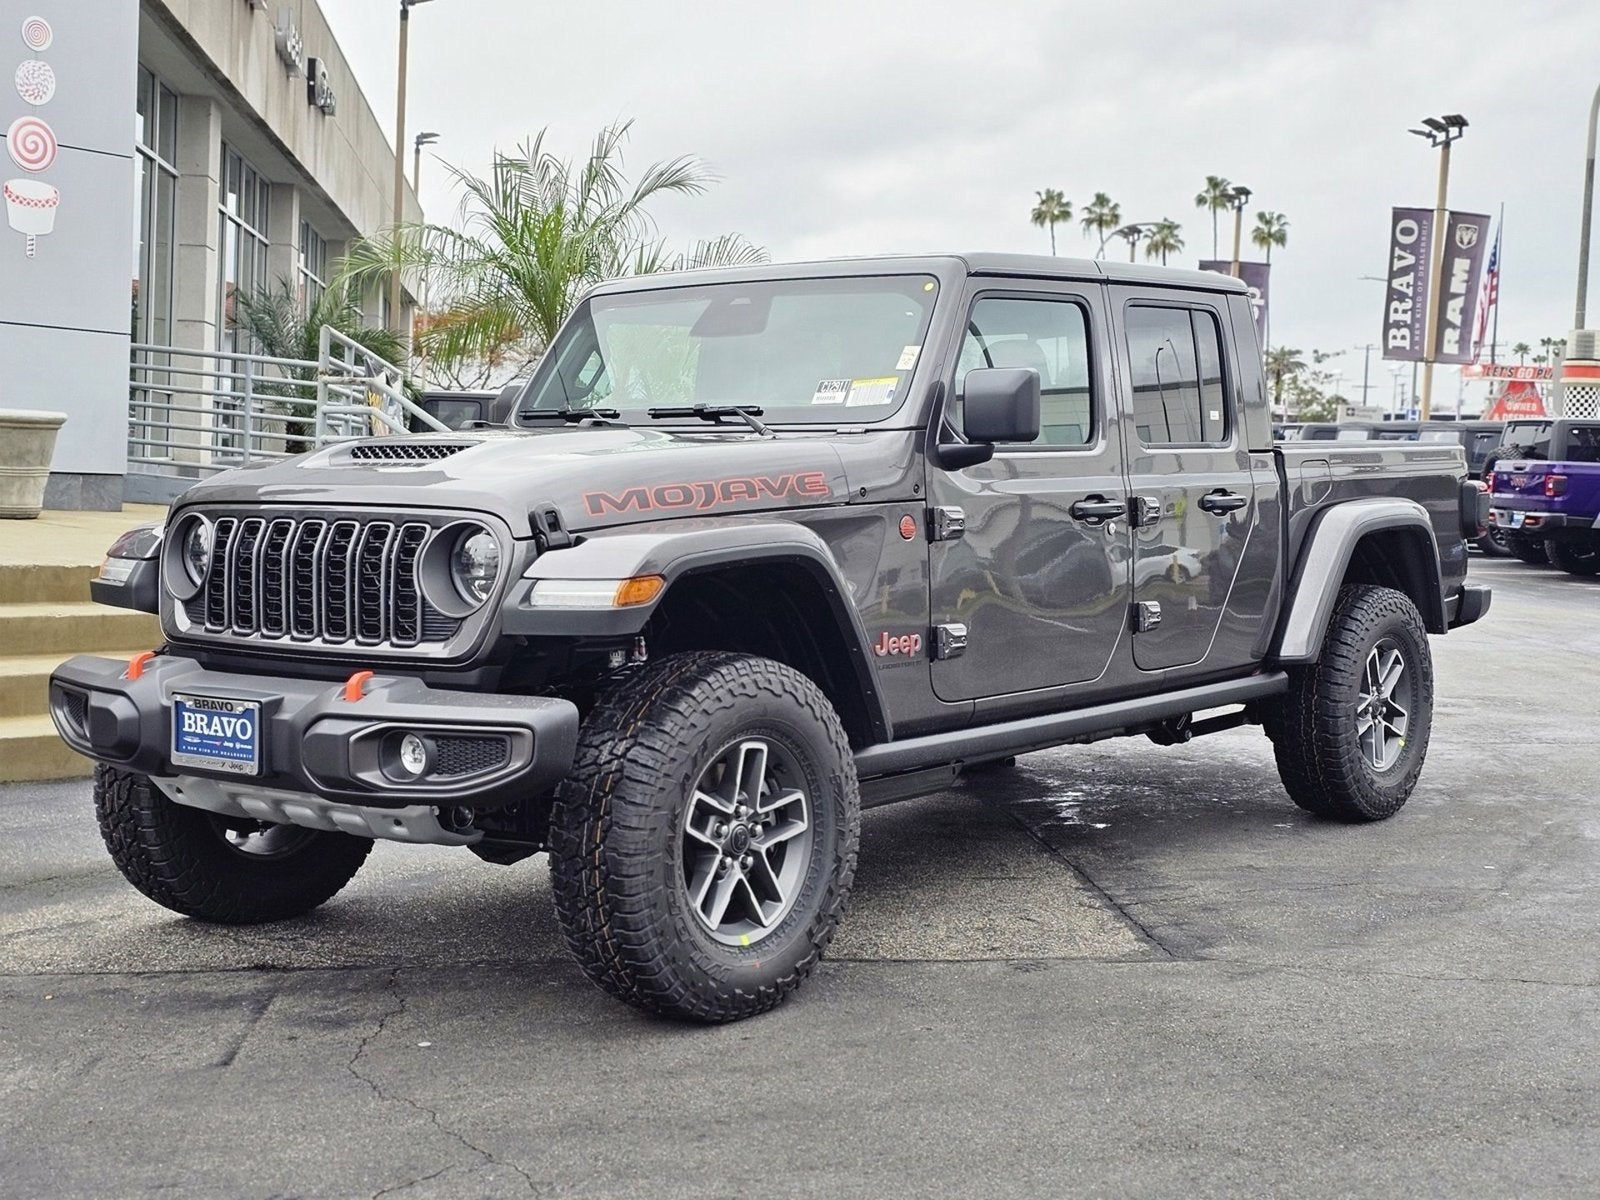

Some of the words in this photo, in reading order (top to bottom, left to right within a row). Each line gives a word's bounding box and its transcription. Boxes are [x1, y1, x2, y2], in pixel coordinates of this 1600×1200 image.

[1418, 220, 1428, 278] DEALERSHIP
[1388, 219, 1418, 351] BRAVO
[1416, 281, 1423, 293] OF
[1443, 257, 1471, 355] RAM
[1486, 366, 1515, 378] LET'S
[1517, 367, 1535, 379] GO
[584, 472, 831, 517] MOJAVE
[874, 631, 922, 658] Jeep
[194, 699, 234, 712] BRAVO
[182, 711, 252, 740] BRAVO
